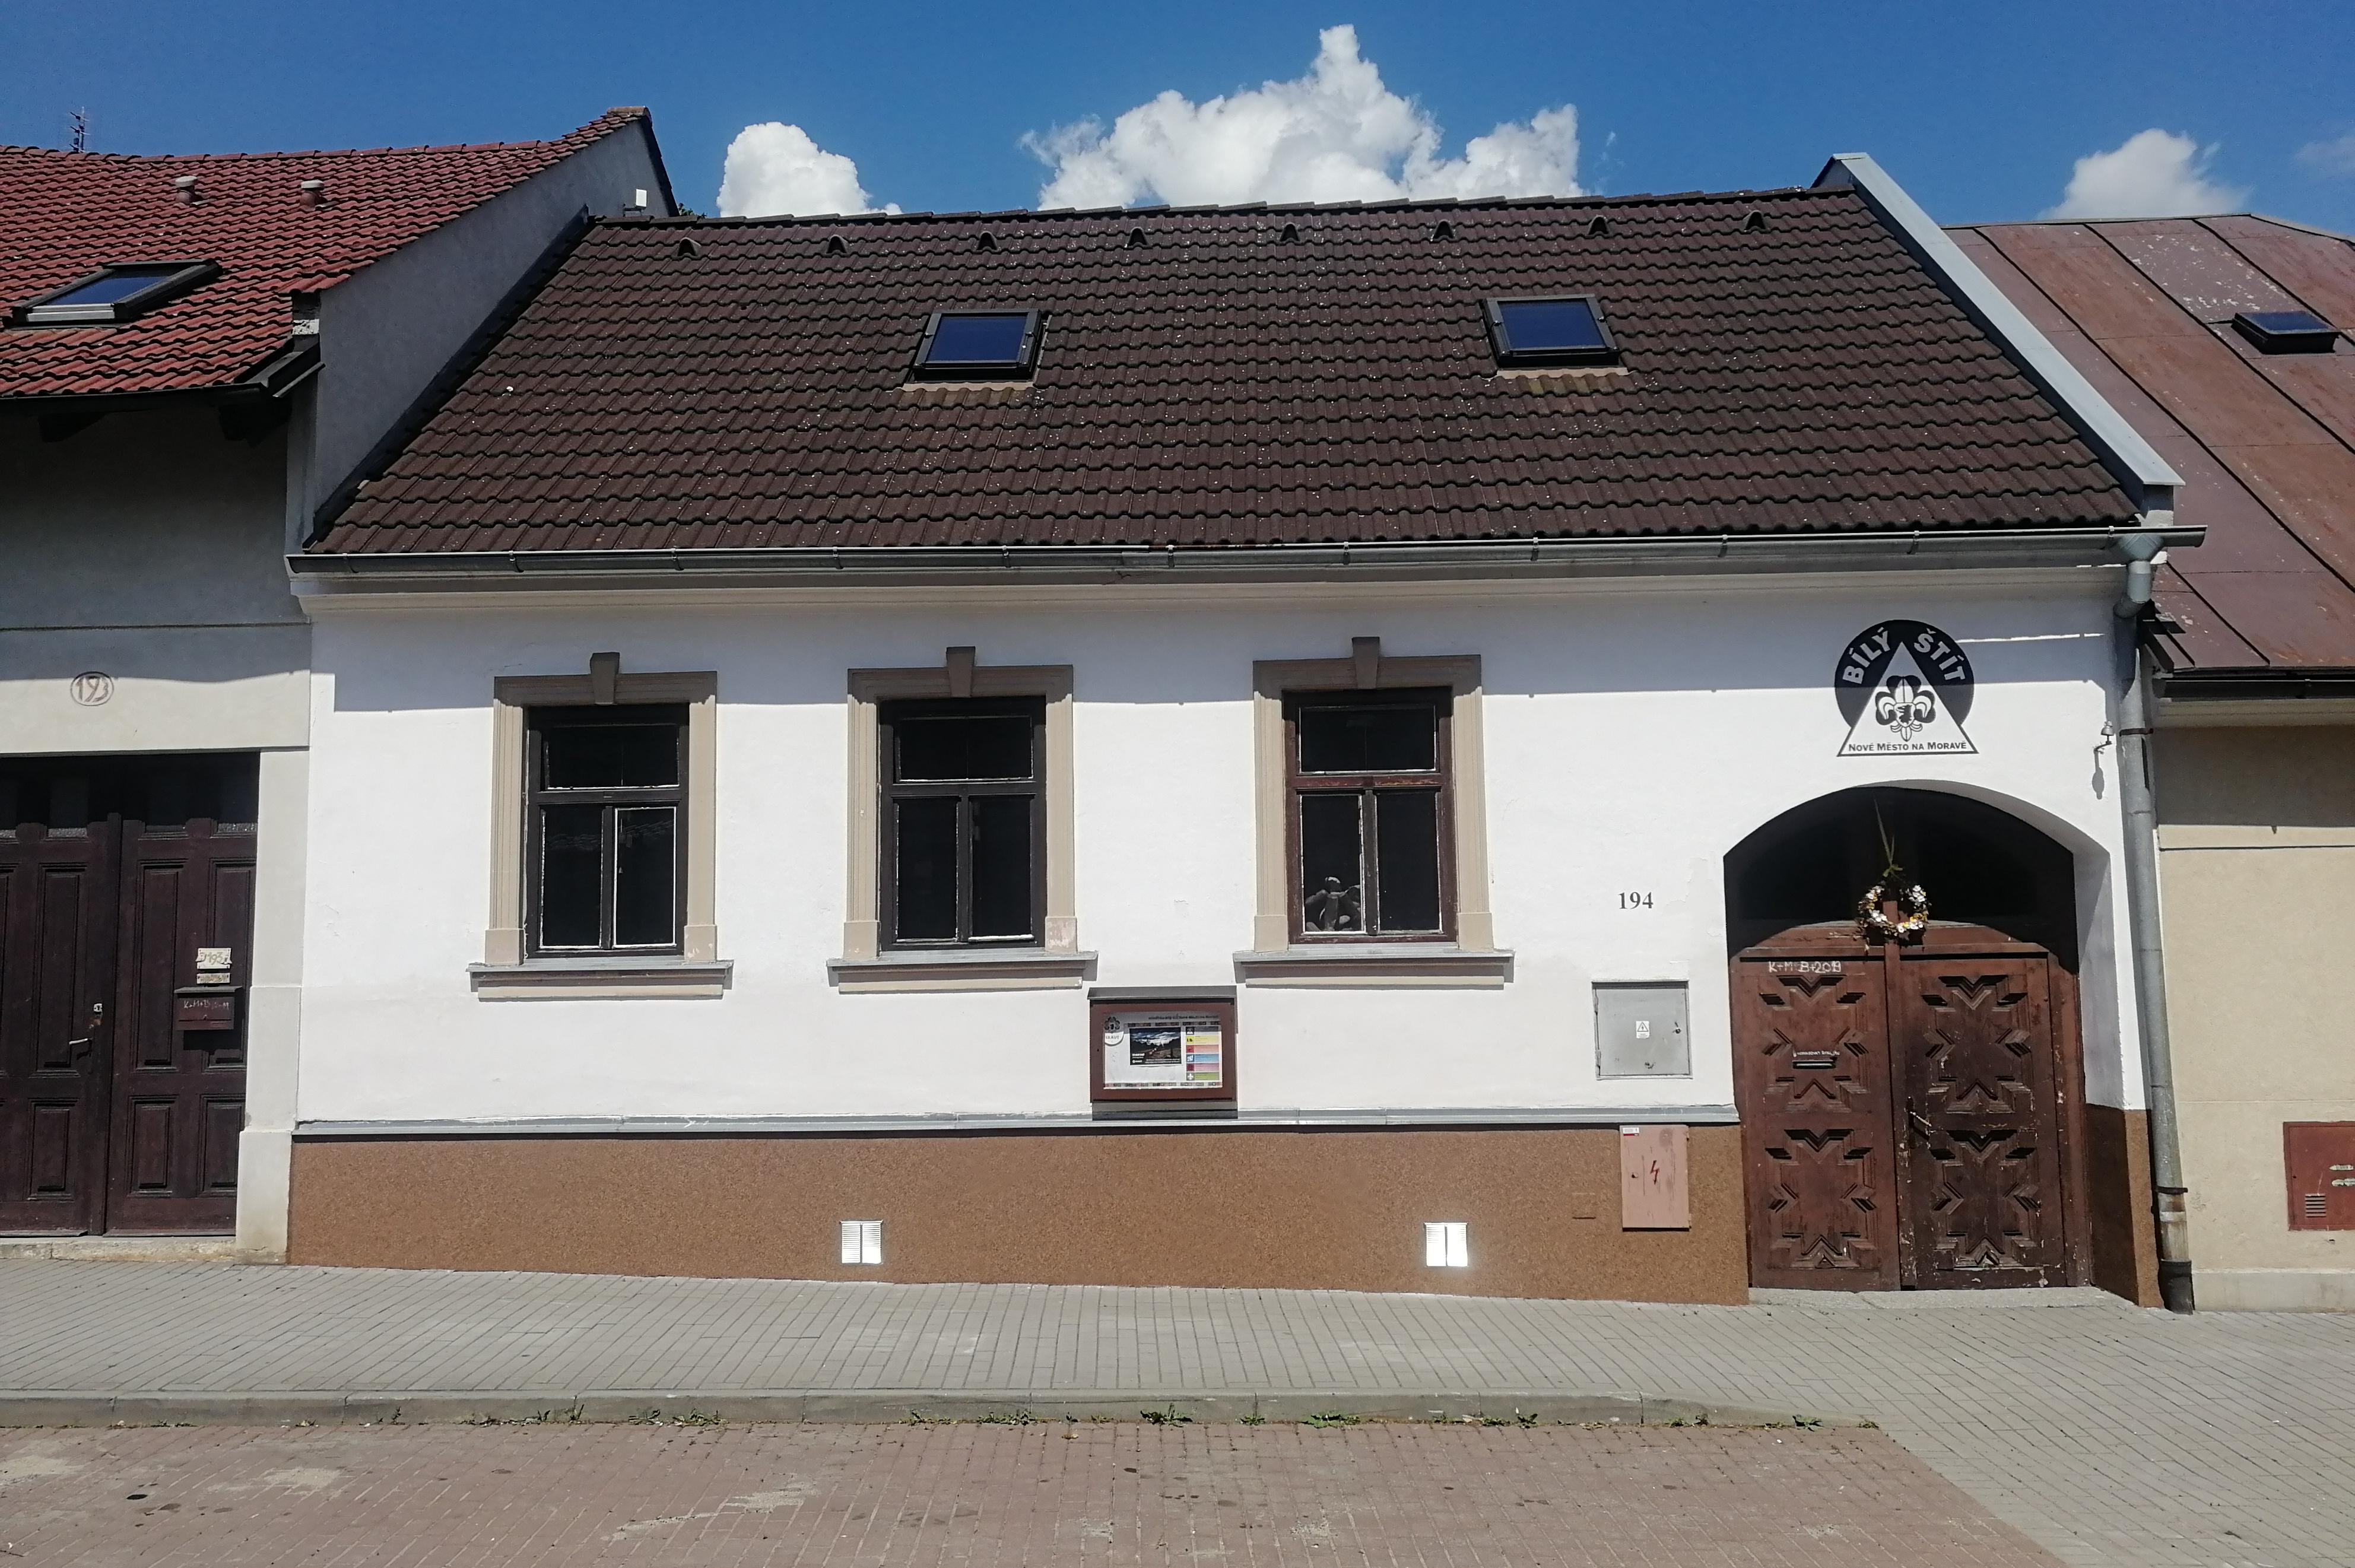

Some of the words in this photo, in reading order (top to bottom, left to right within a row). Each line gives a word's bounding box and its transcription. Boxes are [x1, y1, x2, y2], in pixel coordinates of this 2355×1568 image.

[1842, 627, 1890, 684] BÍLÝ
[1913, 627, 1966, 681] ŠTÍT
[76, 675, 109, 702] 193
[1848, 742, 1874, 751] NOVÉ
[1877, 742, 1909, 751] MĚSTO
[1928, 741, 1967, 750] MORAVĚ
[1618, 891, 1653, 909] 194
